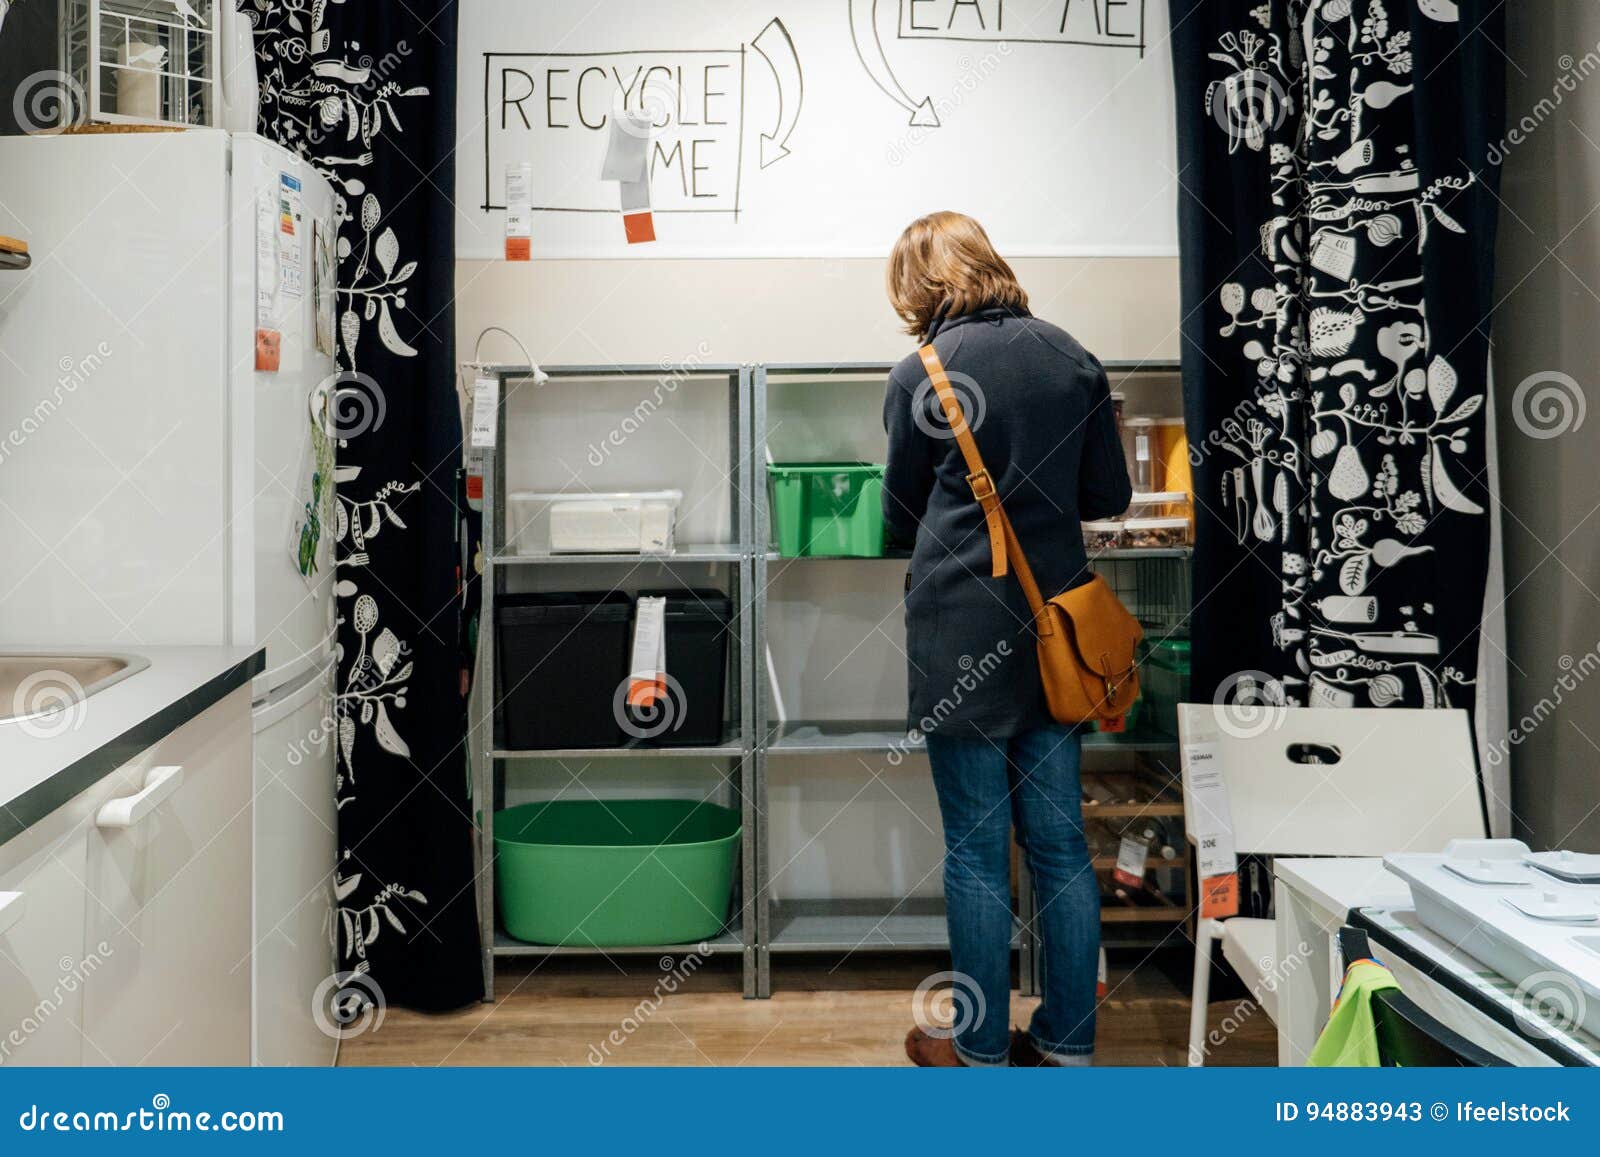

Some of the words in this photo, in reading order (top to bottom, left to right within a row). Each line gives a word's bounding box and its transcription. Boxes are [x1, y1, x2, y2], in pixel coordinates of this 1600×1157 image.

[501, 64, 730, 131] RECYCLE
[650, 139, 718, 198] ME
[1202, 838, 1217, 849] 20€
